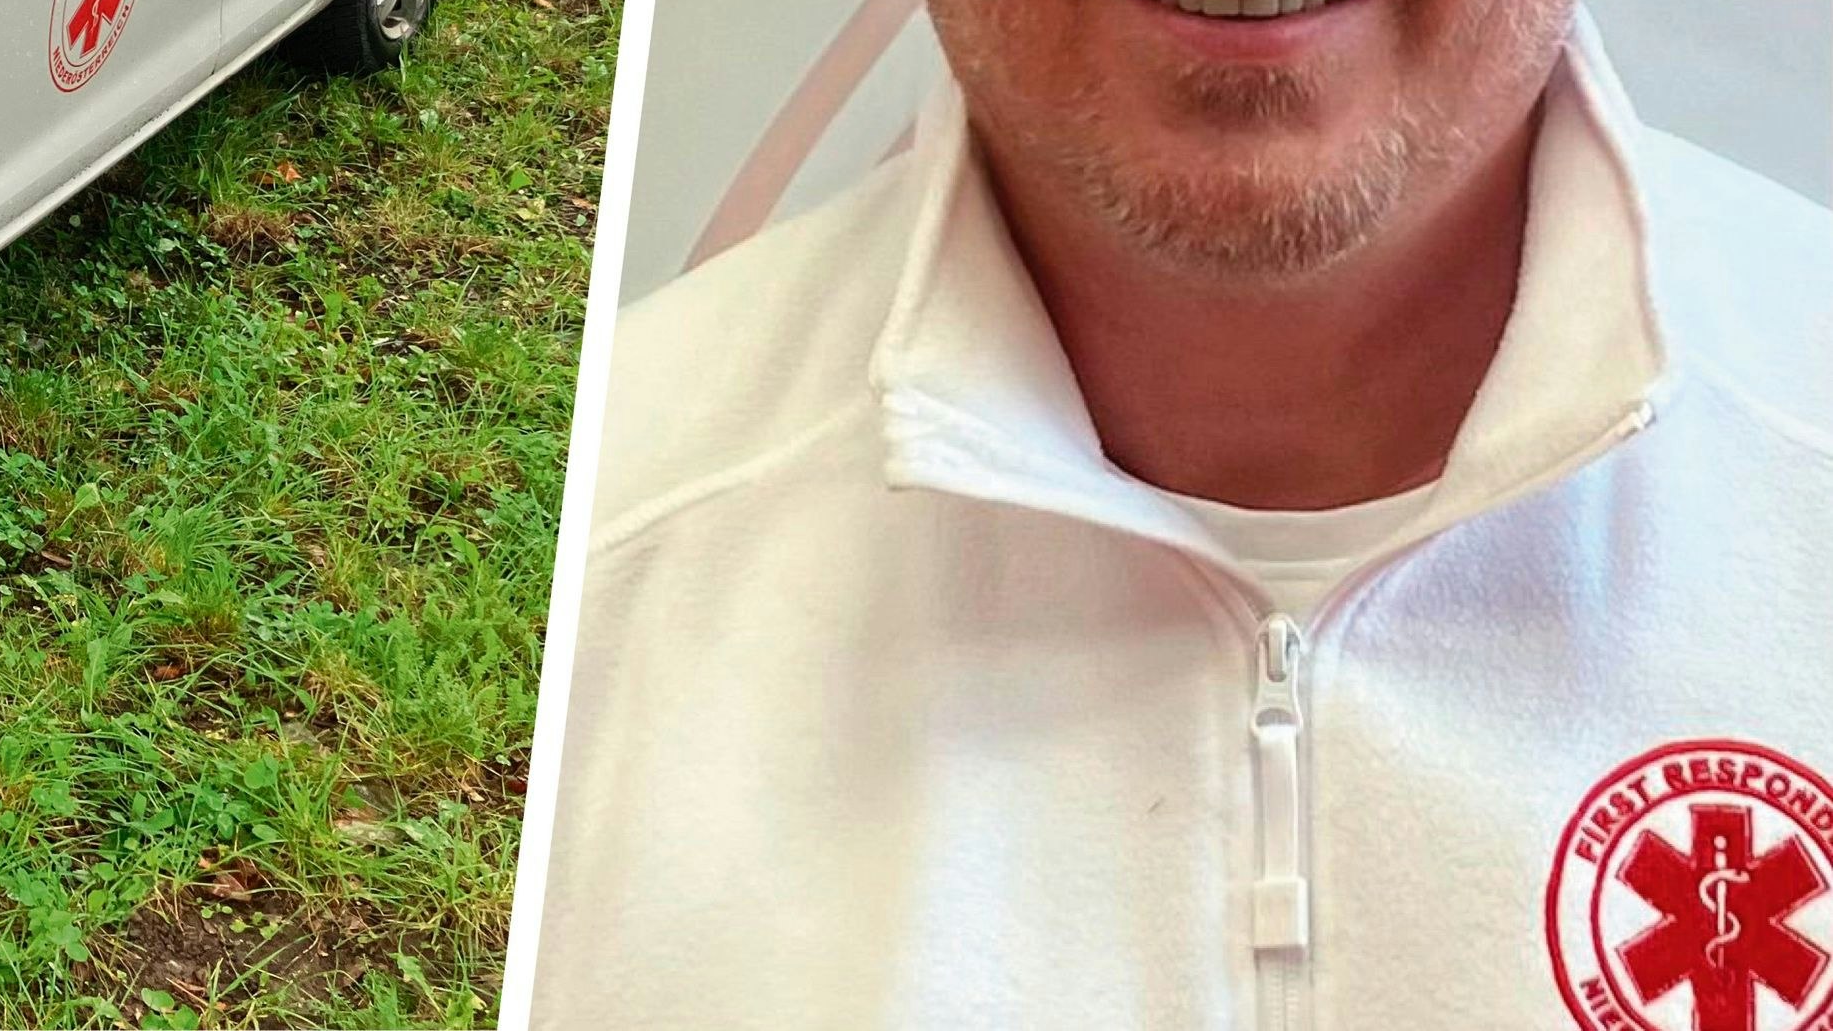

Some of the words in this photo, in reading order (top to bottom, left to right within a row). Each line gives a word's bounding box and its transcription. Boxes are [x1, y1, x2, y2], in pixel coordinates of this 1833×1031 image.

[51, 4, 130, 85] NIEDERÖSTERREICH
[1575, 775, 1653, 864] FIRST
[1661, 758, 1833, 832] RESPOND
